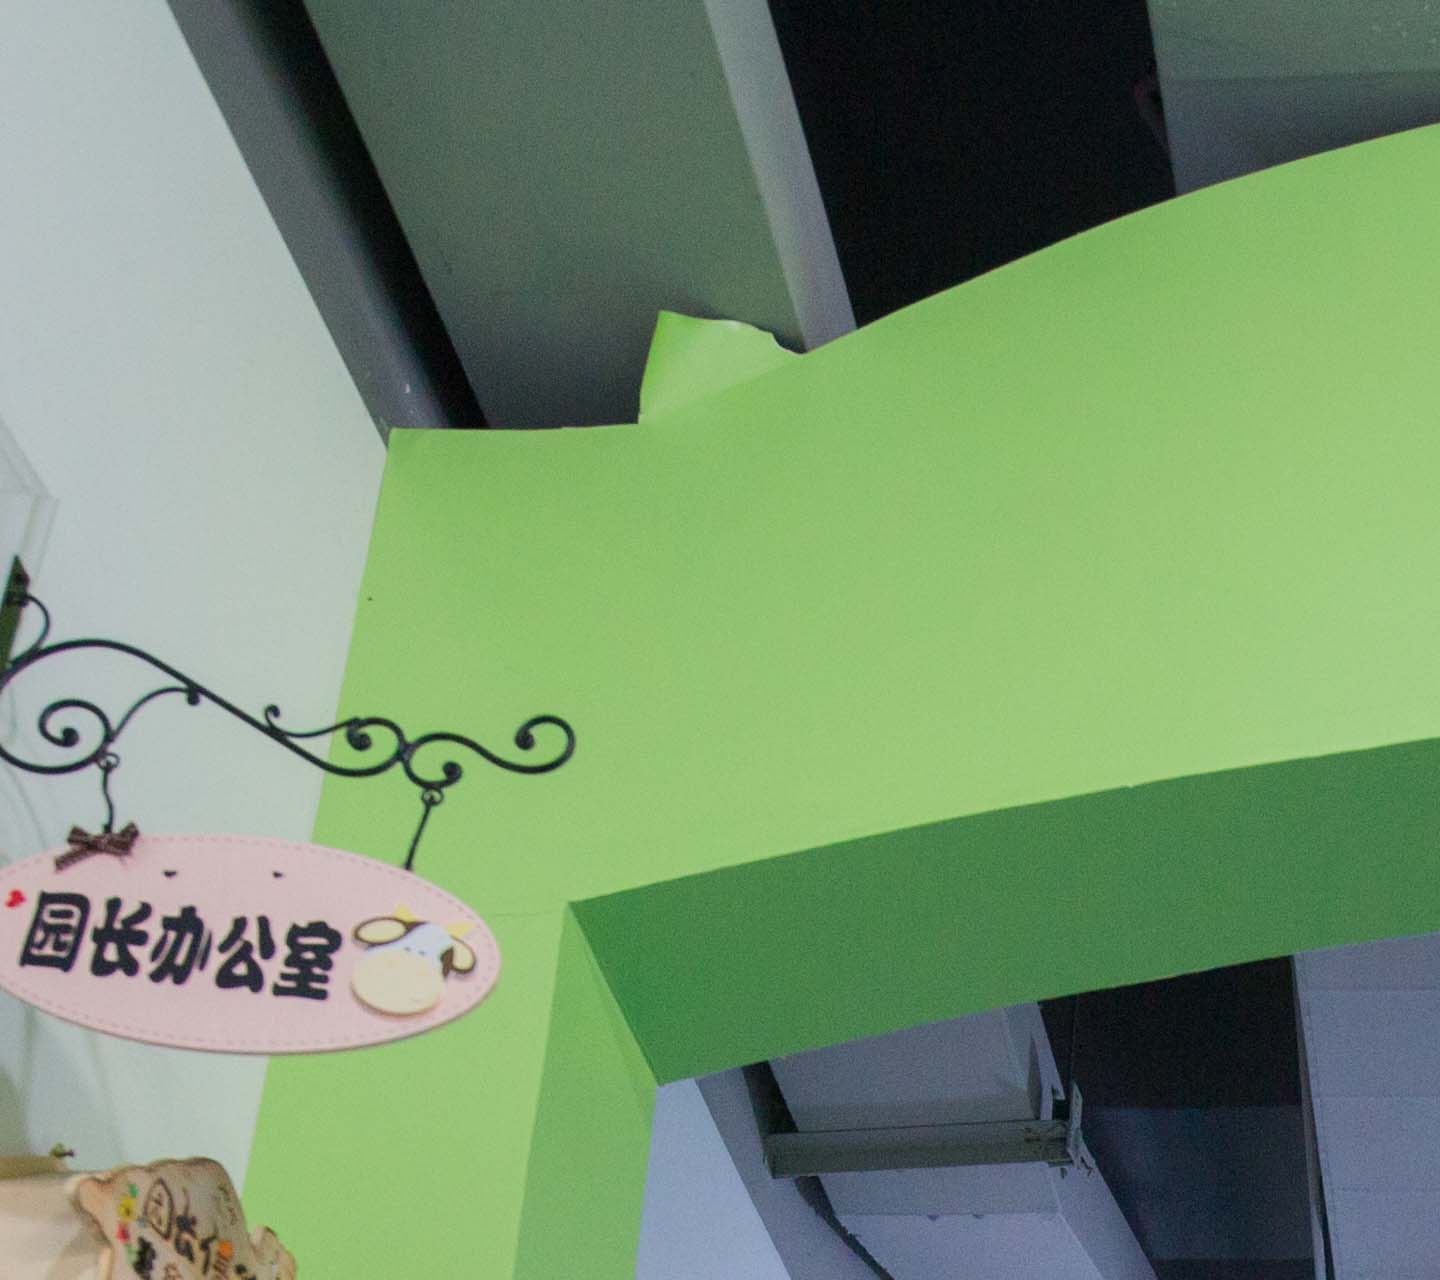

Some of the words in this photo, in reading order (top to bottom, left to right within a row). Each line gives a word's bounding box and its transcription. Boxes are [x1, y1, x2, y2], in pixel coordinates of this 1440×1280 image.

[19, 890, 343, 1001] 园长办公室
